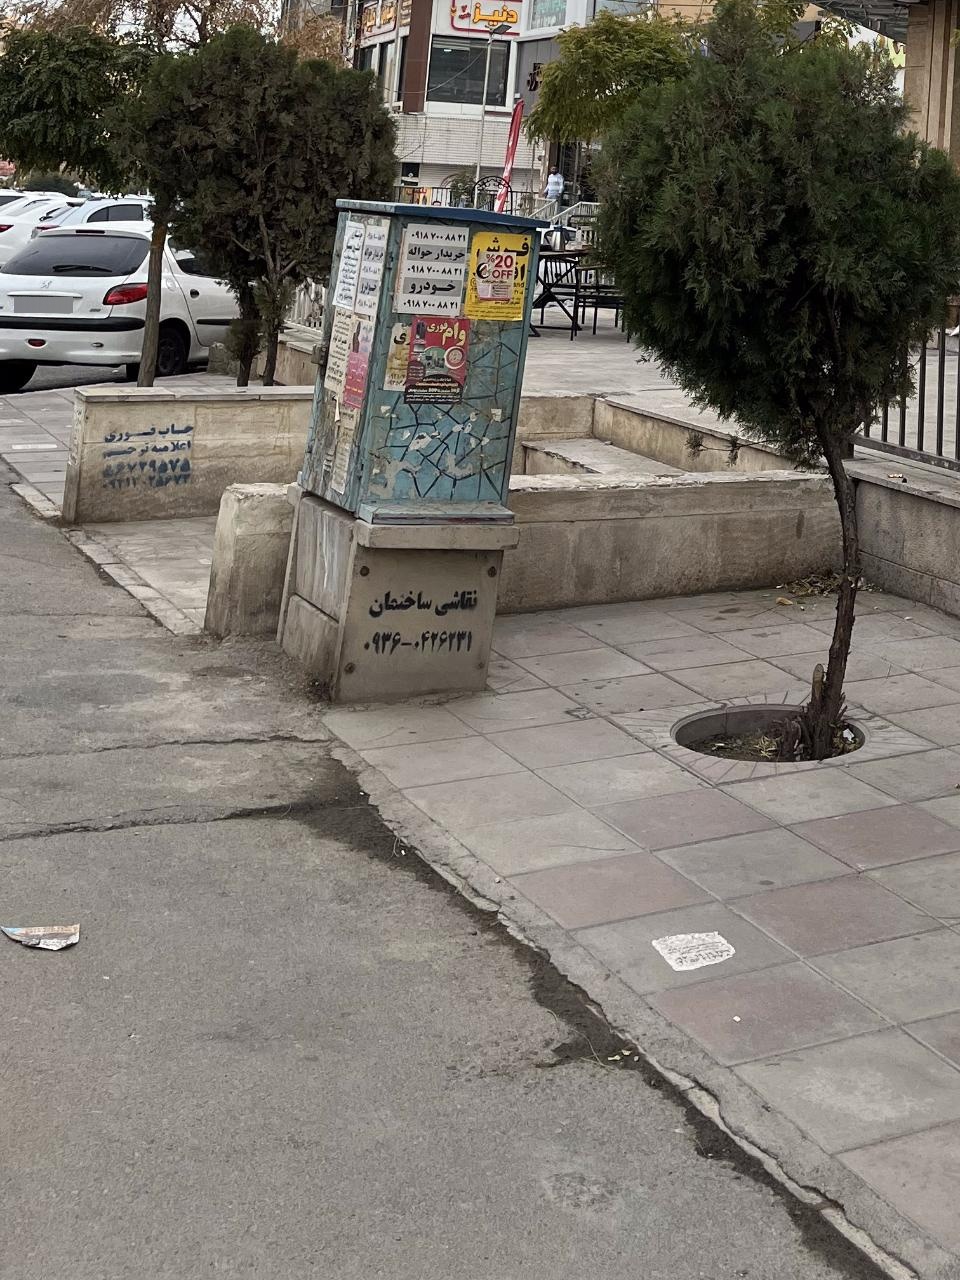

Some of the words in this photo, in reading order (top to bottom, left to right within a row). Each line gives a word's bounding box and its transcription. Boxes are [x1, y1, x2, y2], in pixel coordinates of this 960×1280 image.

[408, 246, 433, 260] حواله
[491, 269, 514, 279] OFF
[408, 280, 456, 295] خودرو
[441, 321, 466, 347] وام
[368, 590, 433, 618] ساختمان
[434, 589, 478, 616] نقاشی
